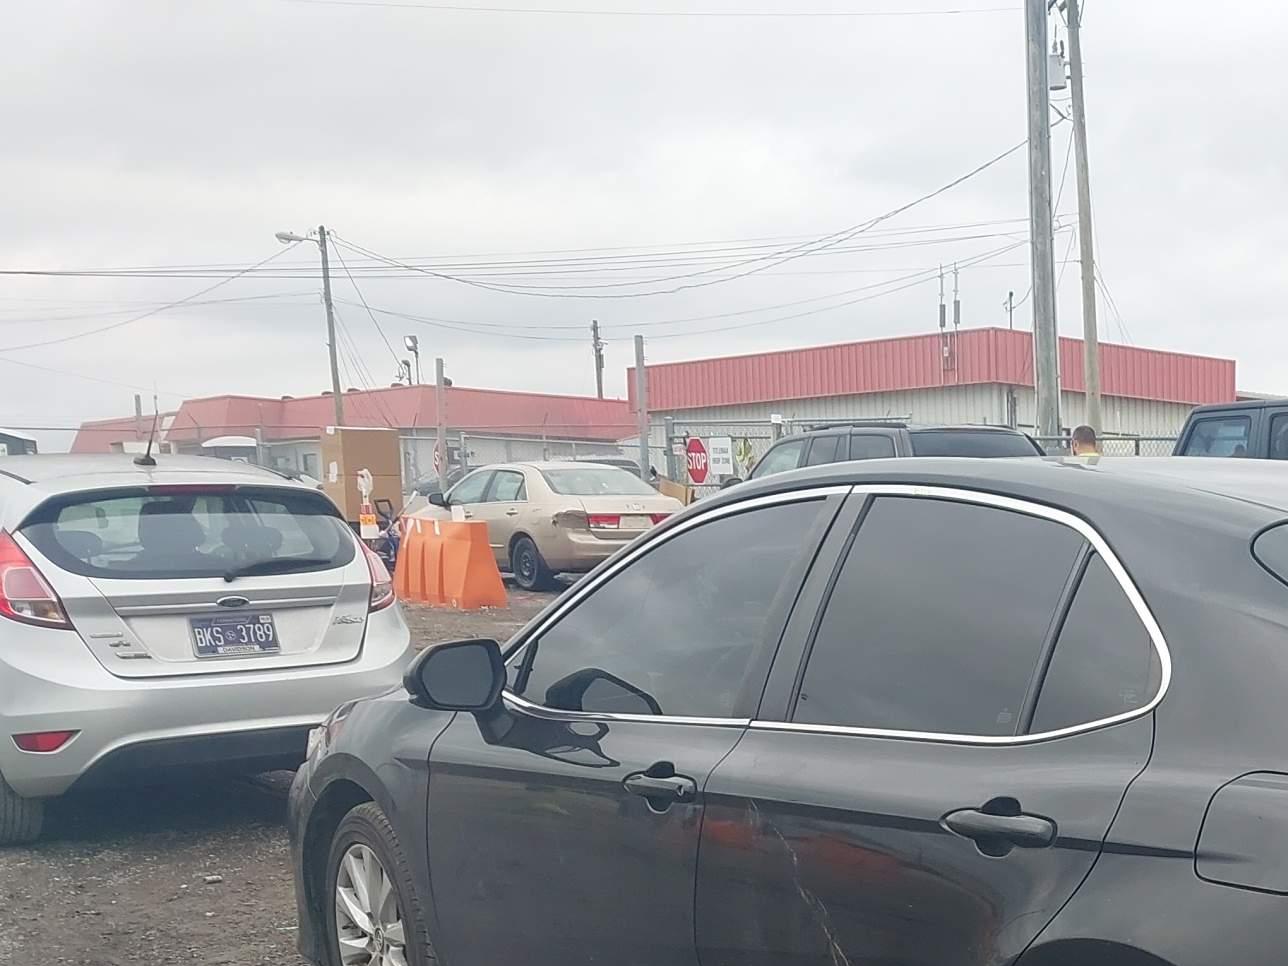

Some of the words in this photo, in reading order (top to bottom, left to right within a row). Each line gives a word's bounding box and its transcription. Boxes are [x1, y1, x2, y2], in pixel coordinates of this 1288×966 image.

[687, 452, 707, 470] STOP
[194, 626, 225, 647] BKS
[236, 623, 274, 643] 3789
